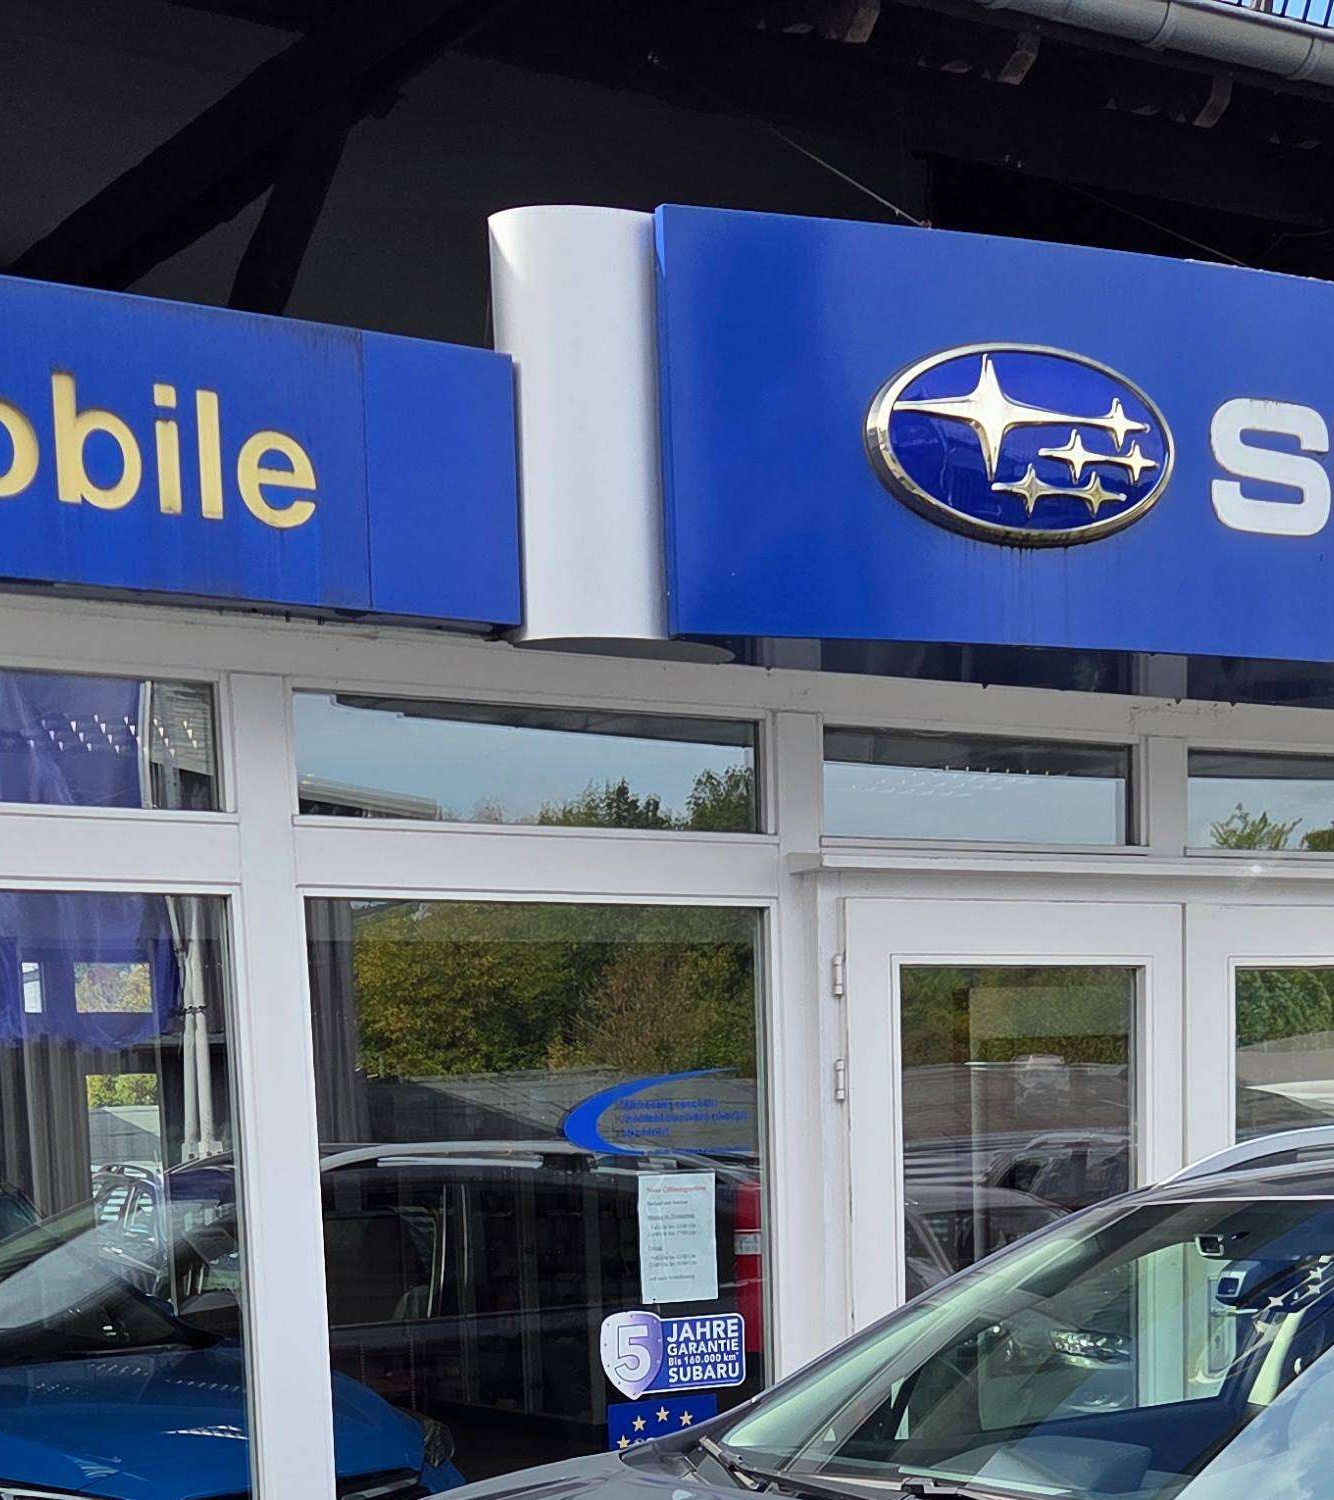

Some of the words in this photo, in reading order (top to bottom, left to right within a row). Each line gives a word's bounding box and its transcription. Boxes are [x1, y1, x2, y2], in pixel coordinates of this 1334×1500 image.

[667, 1319, 739, 1343] JAHRE
[615, 1325, 651, 1382] 5
[667, 1339, 740, 1356] GARANTIE
[684, 1353, 721, 1366] 160.000
[668, 1362, 740, 1384] SUBARU
